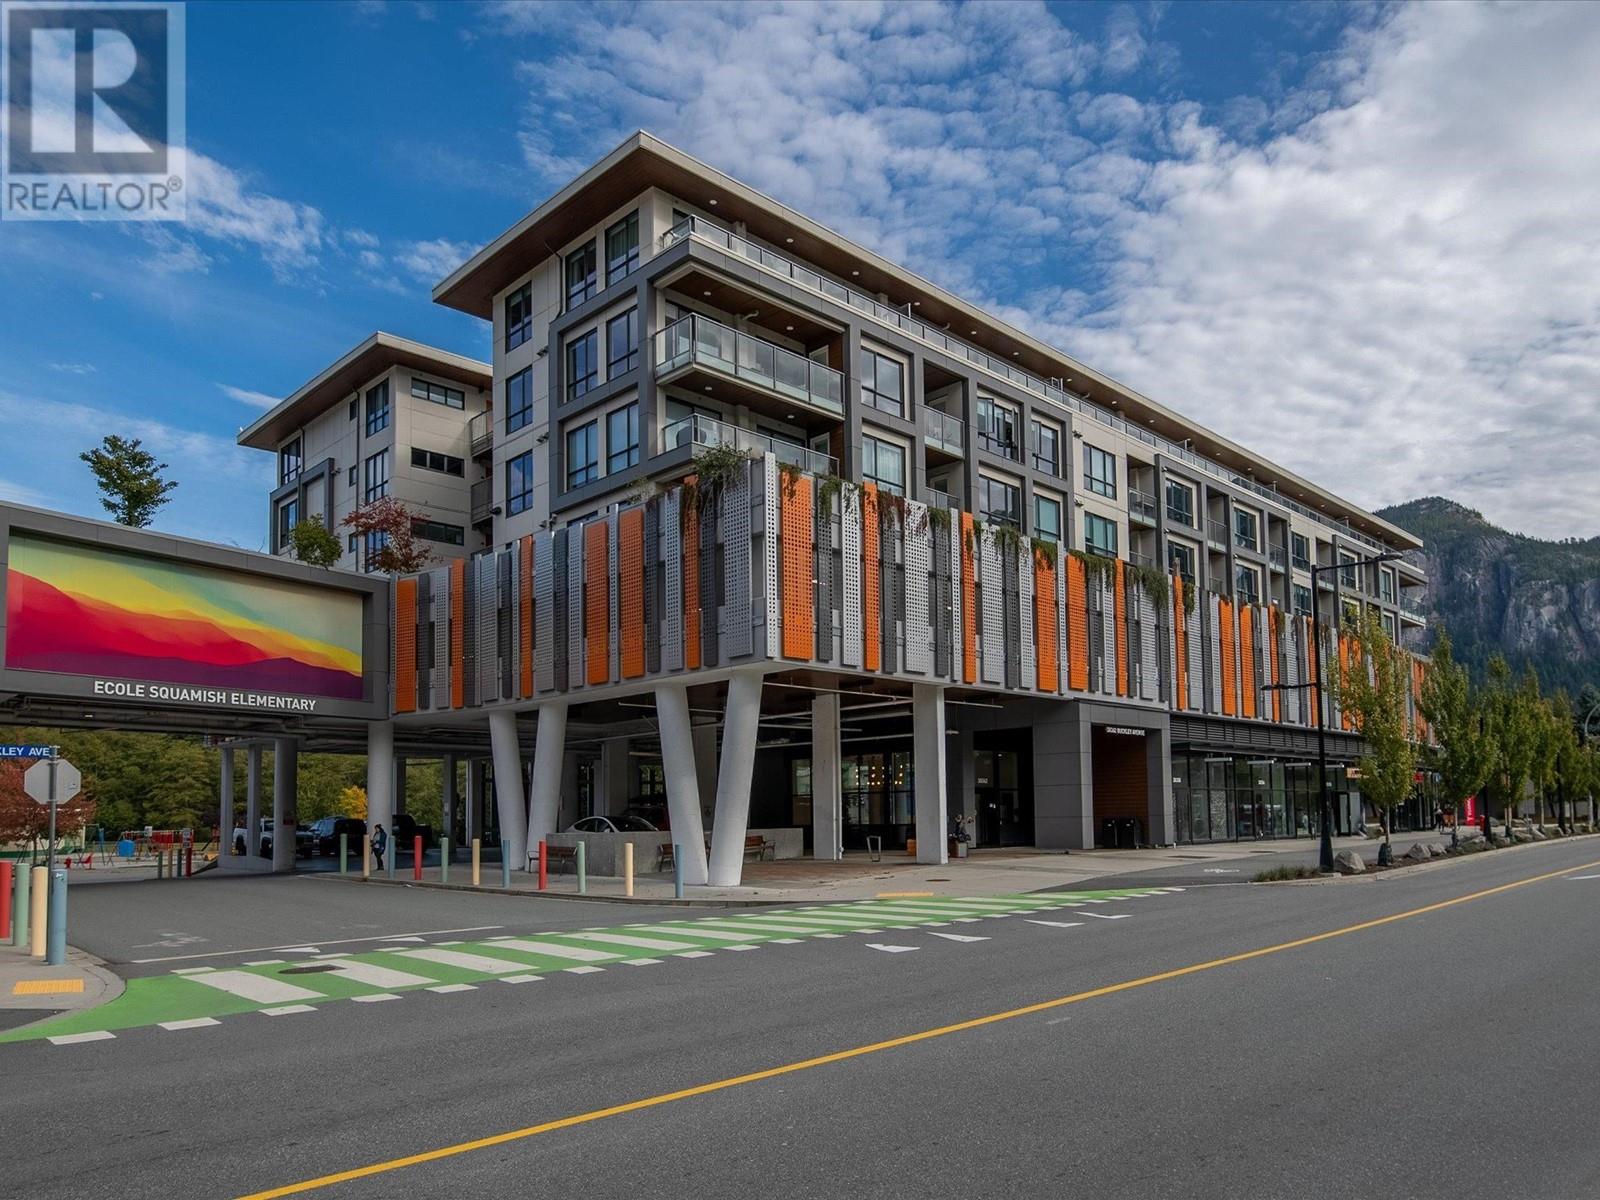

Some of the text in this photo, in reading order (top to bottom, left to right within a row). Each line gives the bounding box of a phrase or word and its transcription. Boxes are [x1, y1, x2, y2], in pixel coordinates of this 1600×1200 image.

[94, 680, 316, 711] ECOLE SQUAMISH ELEMENTARY
[0, 747, 50, 756] LEY AVE
